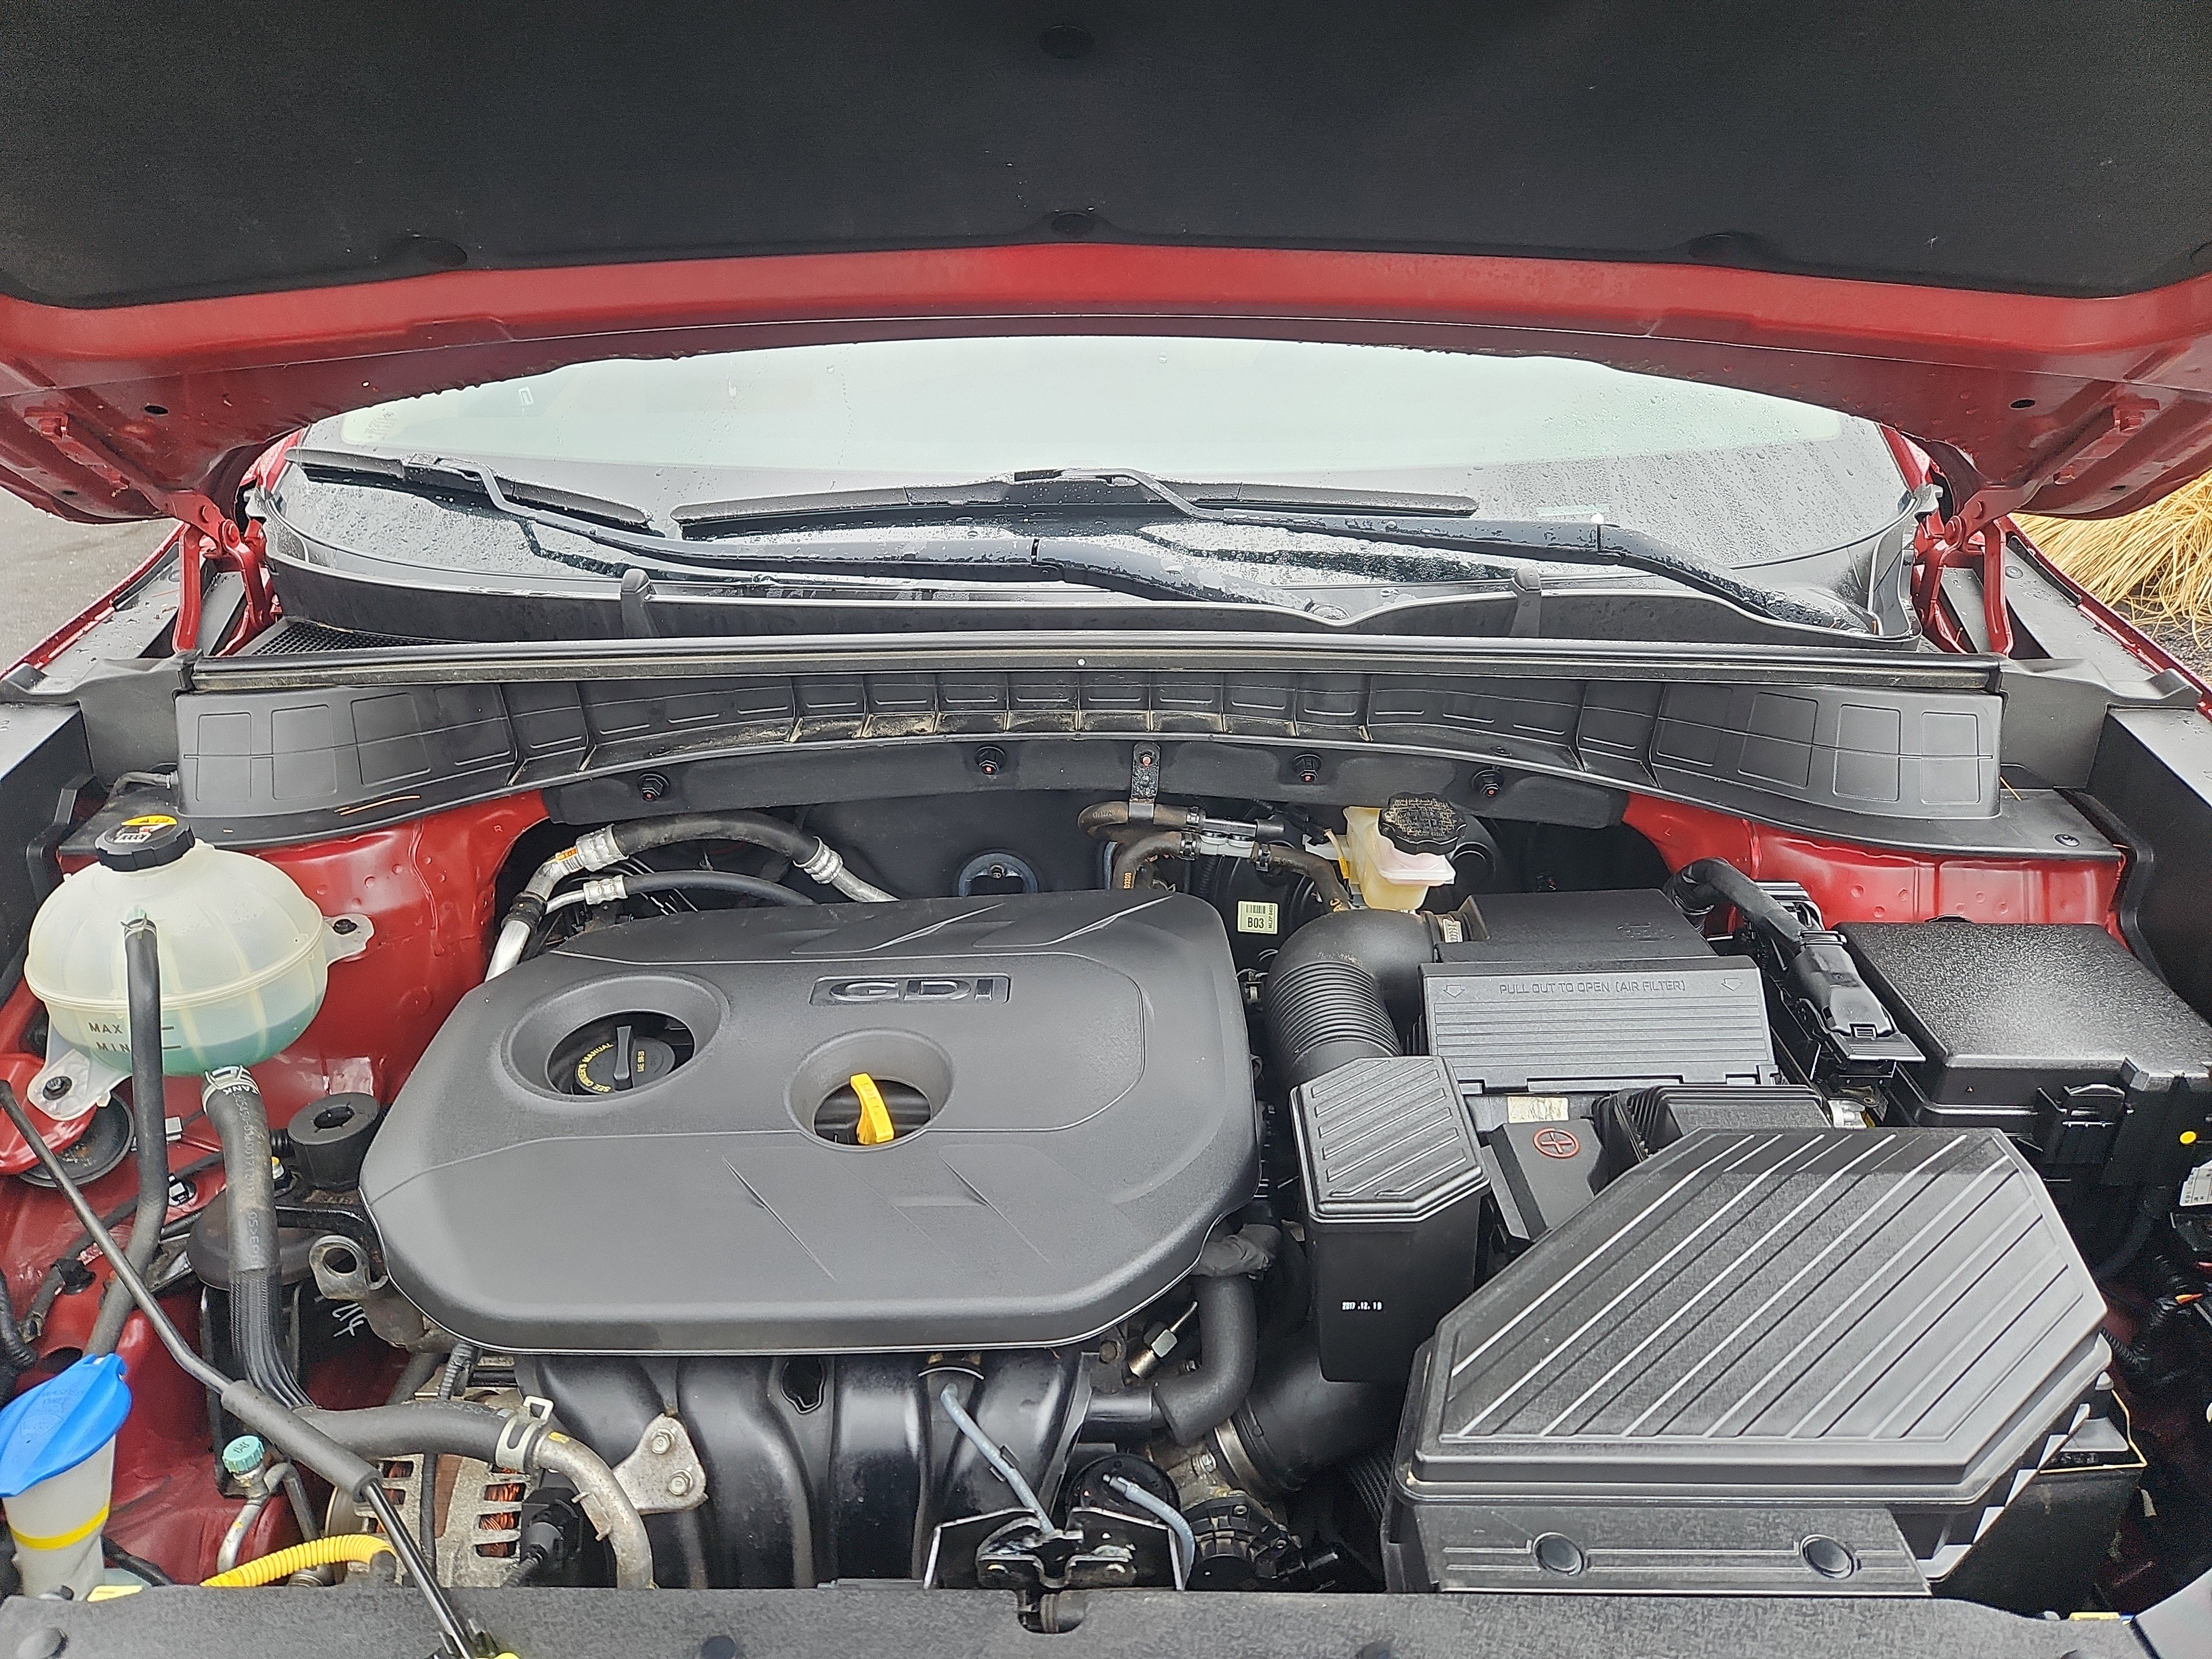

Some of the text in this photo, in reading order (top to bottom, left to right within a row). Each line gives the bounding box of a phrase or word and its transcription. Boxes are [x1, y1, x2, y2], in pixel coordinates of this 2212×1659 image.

[1248, 917, 1264, 929] B03
[829, 978, 994, 1001] GDI
[1499, 983, 1529, 994] PULL
[1532, 982, 1556, 993] OUT
[1558, 982, 1574, 993] TO
[1577, 981, 1610, 993] OPEN
[88, 1021, 123, 1034] MAX
[96, 1041, 131, 1052] MIN
[582, 1042, 614, 1063] MANUAL
[591, 1083, 612, 1093] SEE
[233, 1441, 250, 1454] H
